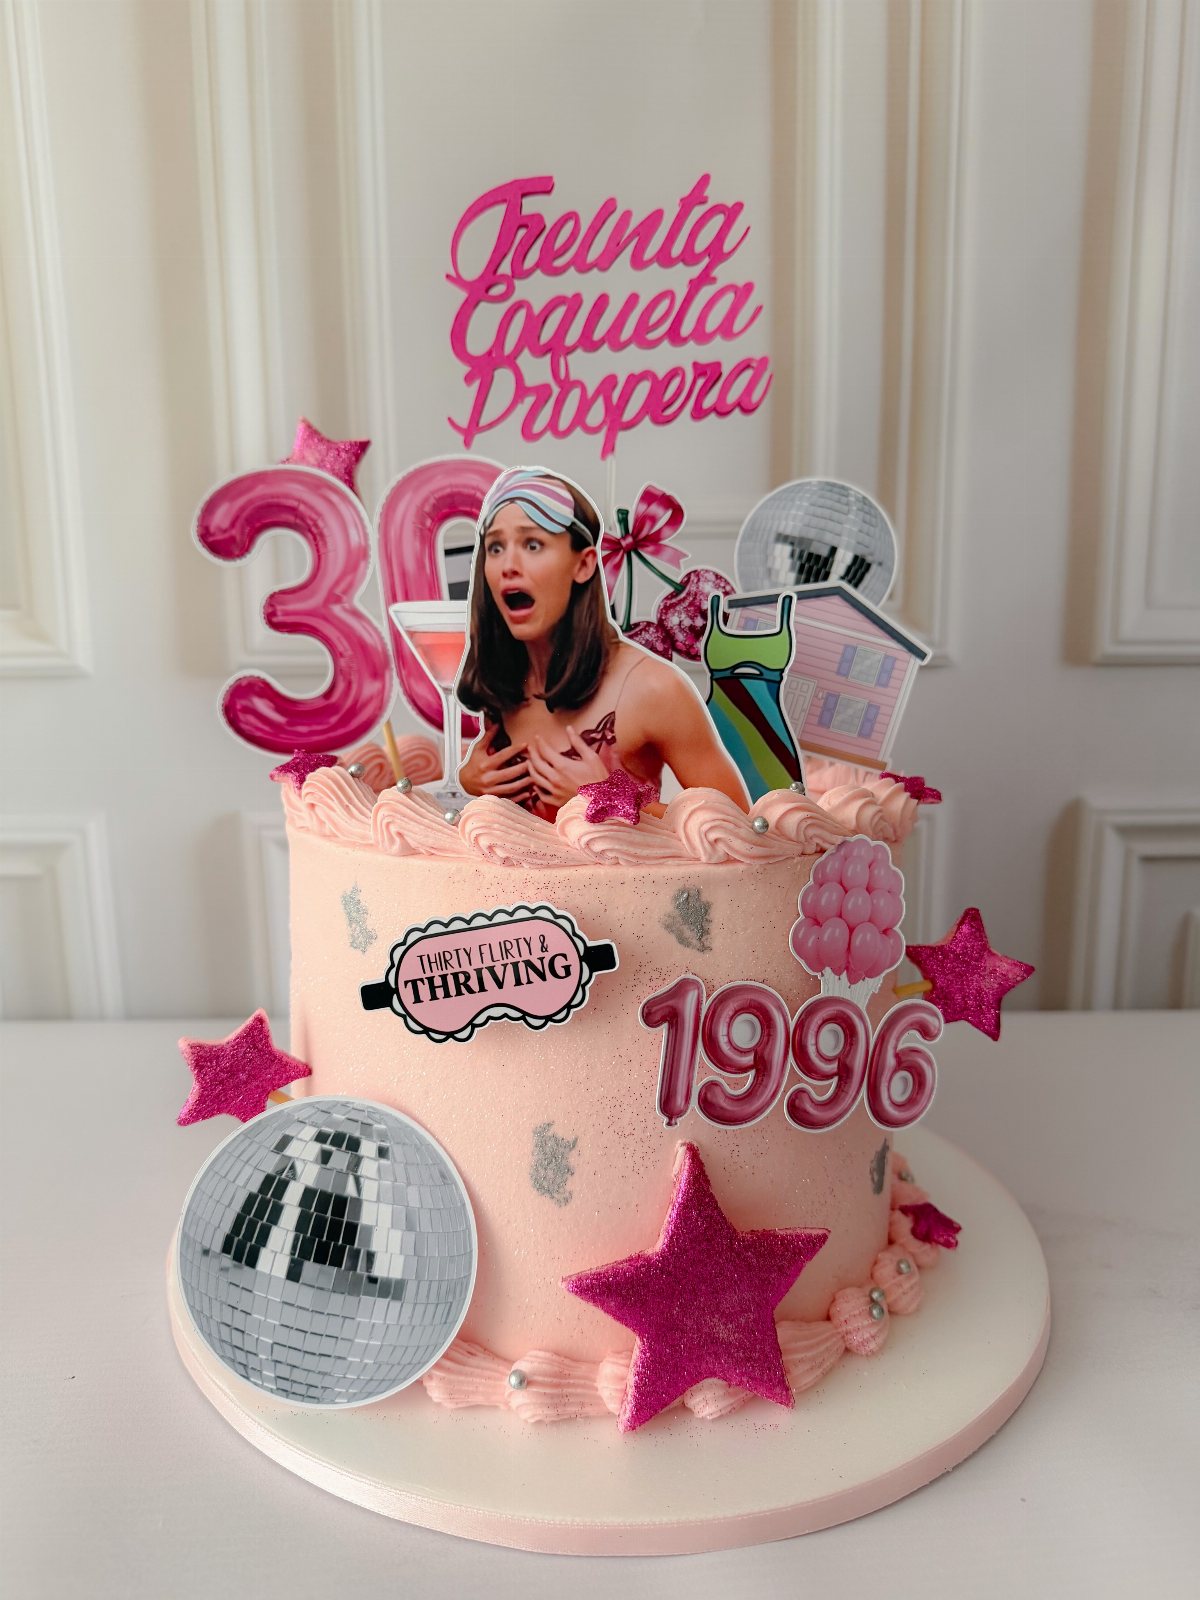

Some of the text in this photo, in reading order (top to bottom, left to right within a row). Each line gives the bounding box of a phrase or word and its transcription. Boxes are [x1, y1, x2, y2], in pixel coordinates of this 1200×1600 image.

[446, 172, 750, 284] Treinta
[450, 272, 763, 384] Coqueta
[448, 355, 773, 461] Prospera
[404, 952, 572, 1004] THRIVING
[417, 933, 550, 975] THIRTY FLIRTY &
[638, 974, 944, 1132] 1996
